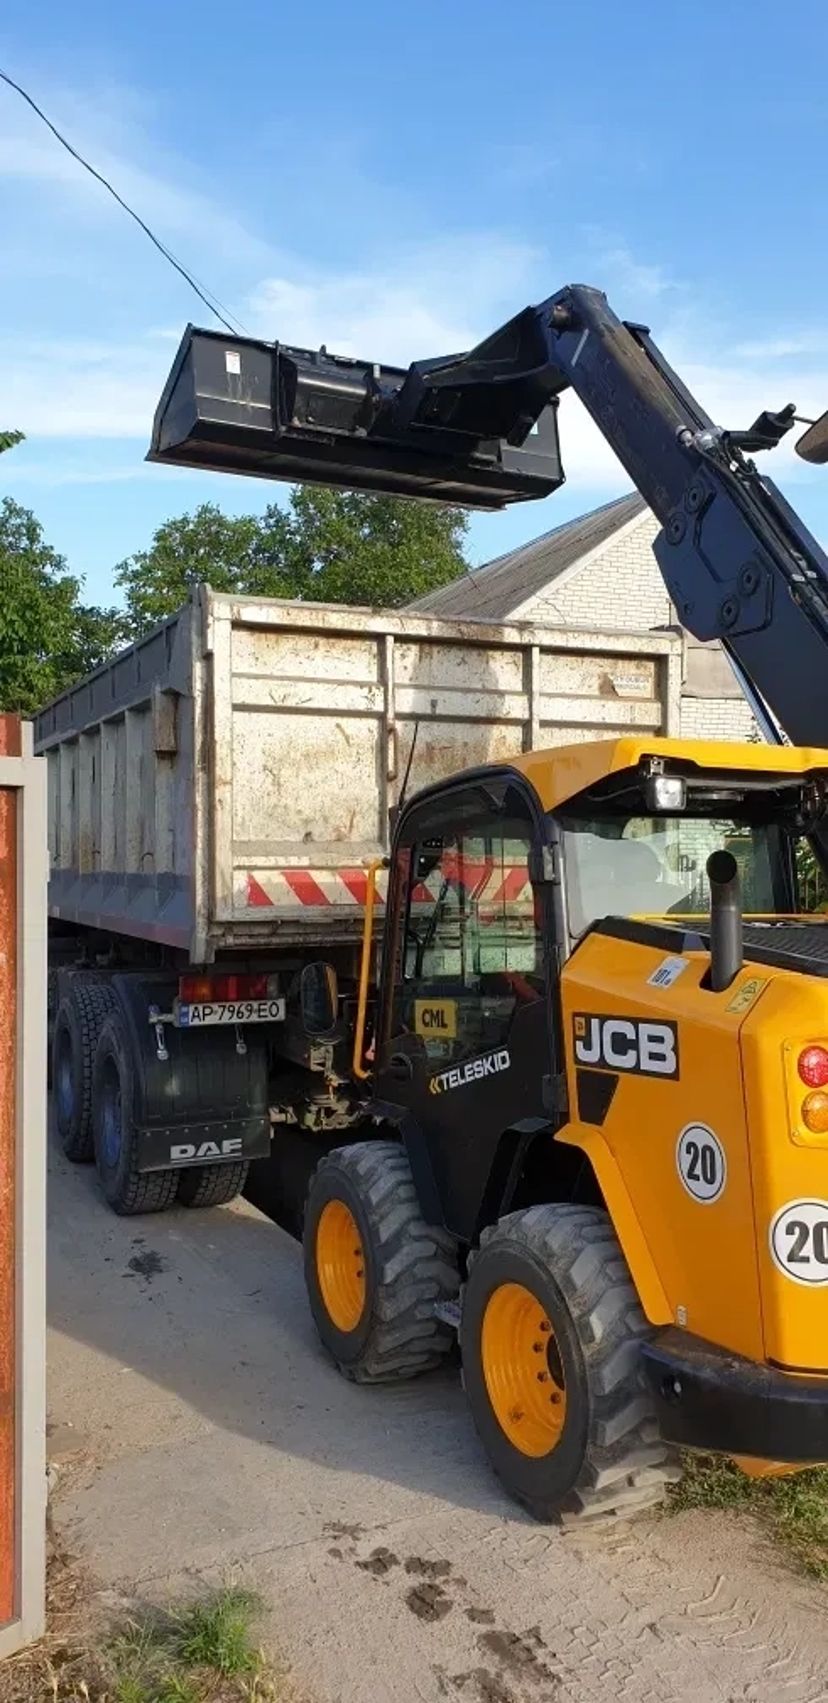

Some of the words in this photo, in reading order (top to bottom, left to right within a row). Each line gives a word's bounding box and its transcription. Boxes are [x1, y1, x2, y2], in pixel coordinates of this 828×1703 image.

[190, 1005, 213, 1022] AP
[217, 1003, 253, 1020] 7969
[257, 1001, 280, 1018] EO
[422, 1008, 448, 1028] CML
[575, 1018, 677, 1073] JCB
[440, 1051, 511, 1090] TELESKID
[170, 1138, 242, 1160] DAF
[685, 1141, 716, 1185] 20
[785, 1220, 828, 1264] 20
